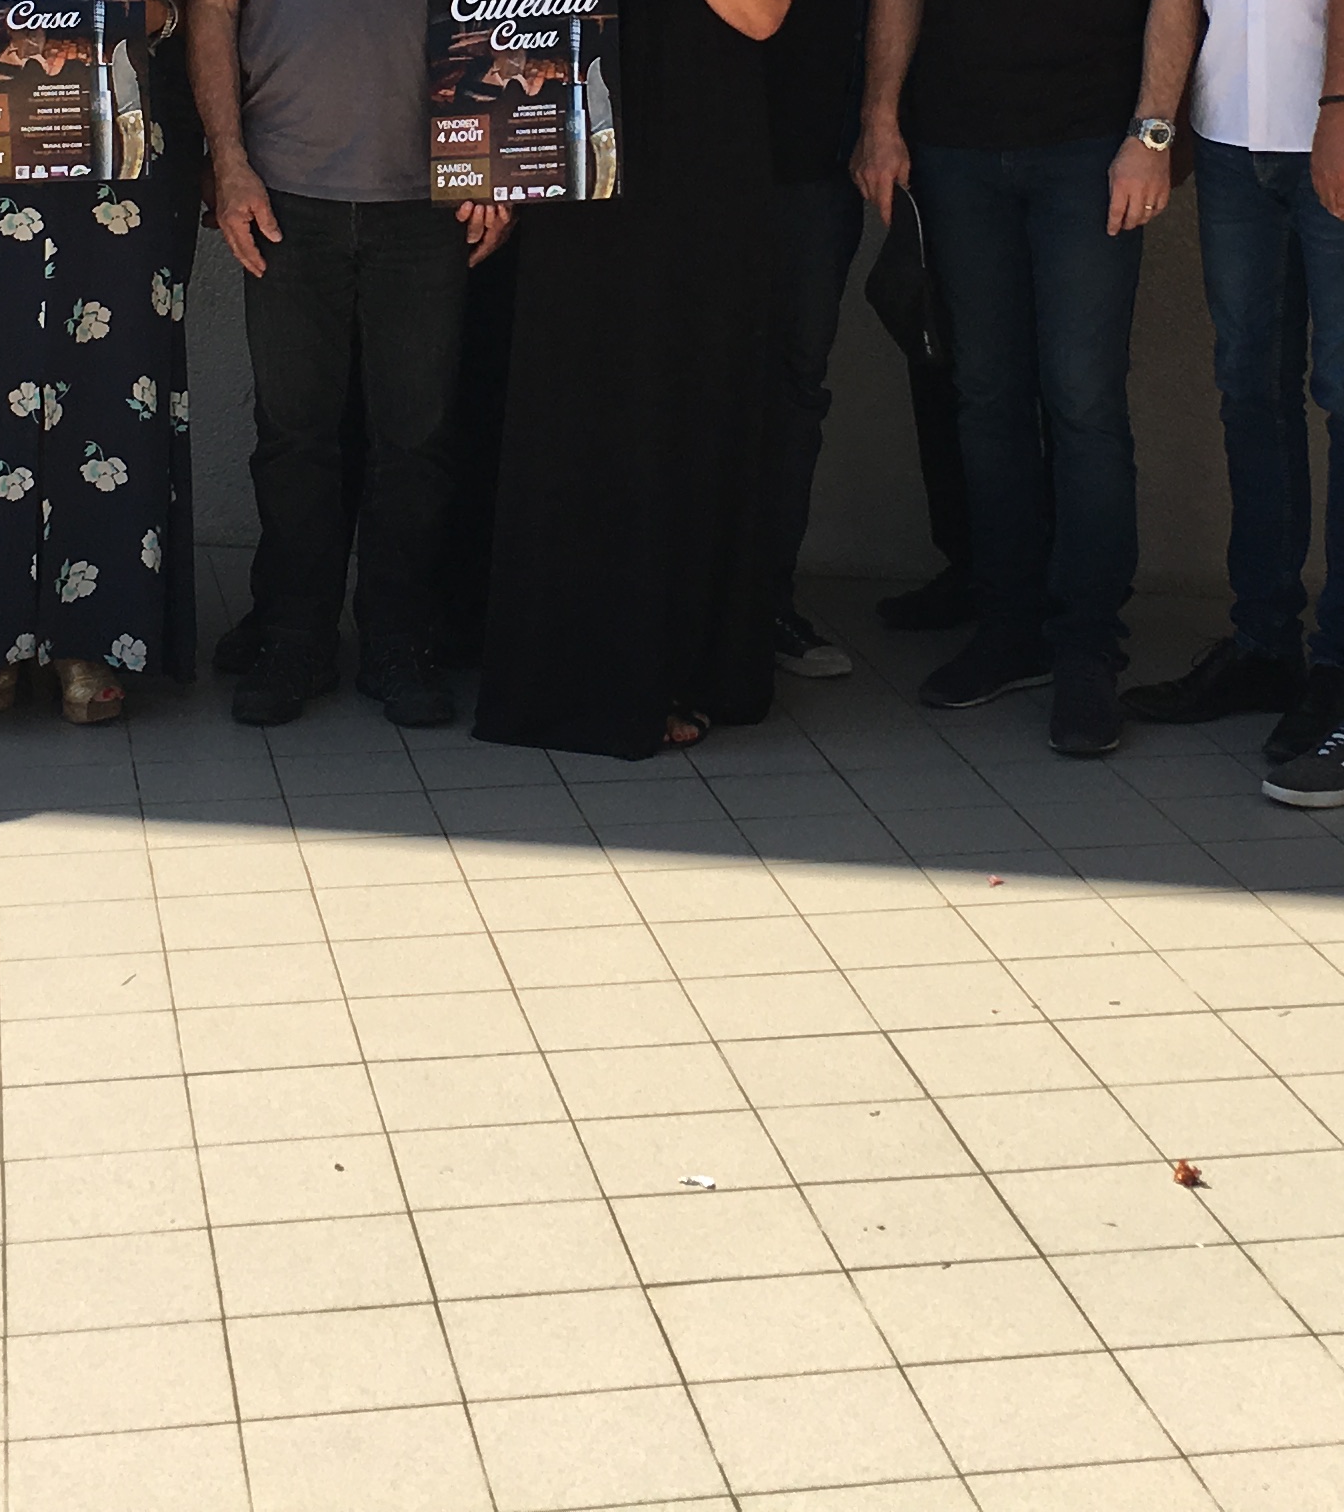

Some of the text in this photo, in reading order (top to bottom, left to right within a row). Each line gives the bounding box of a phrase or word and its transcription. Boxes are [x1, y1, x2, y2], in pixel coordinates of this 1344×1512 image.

[6, 0, 81, 30] Corsa
[490, 20, 559, 50] Corsa
[437, 119, 479, 129] VENDREDI
[437, 127, 484, 143] 4 AOÛT
[436, 163, 471, 174] SAMEDI
[437, 171, 484, 188] 5 AOÛT
